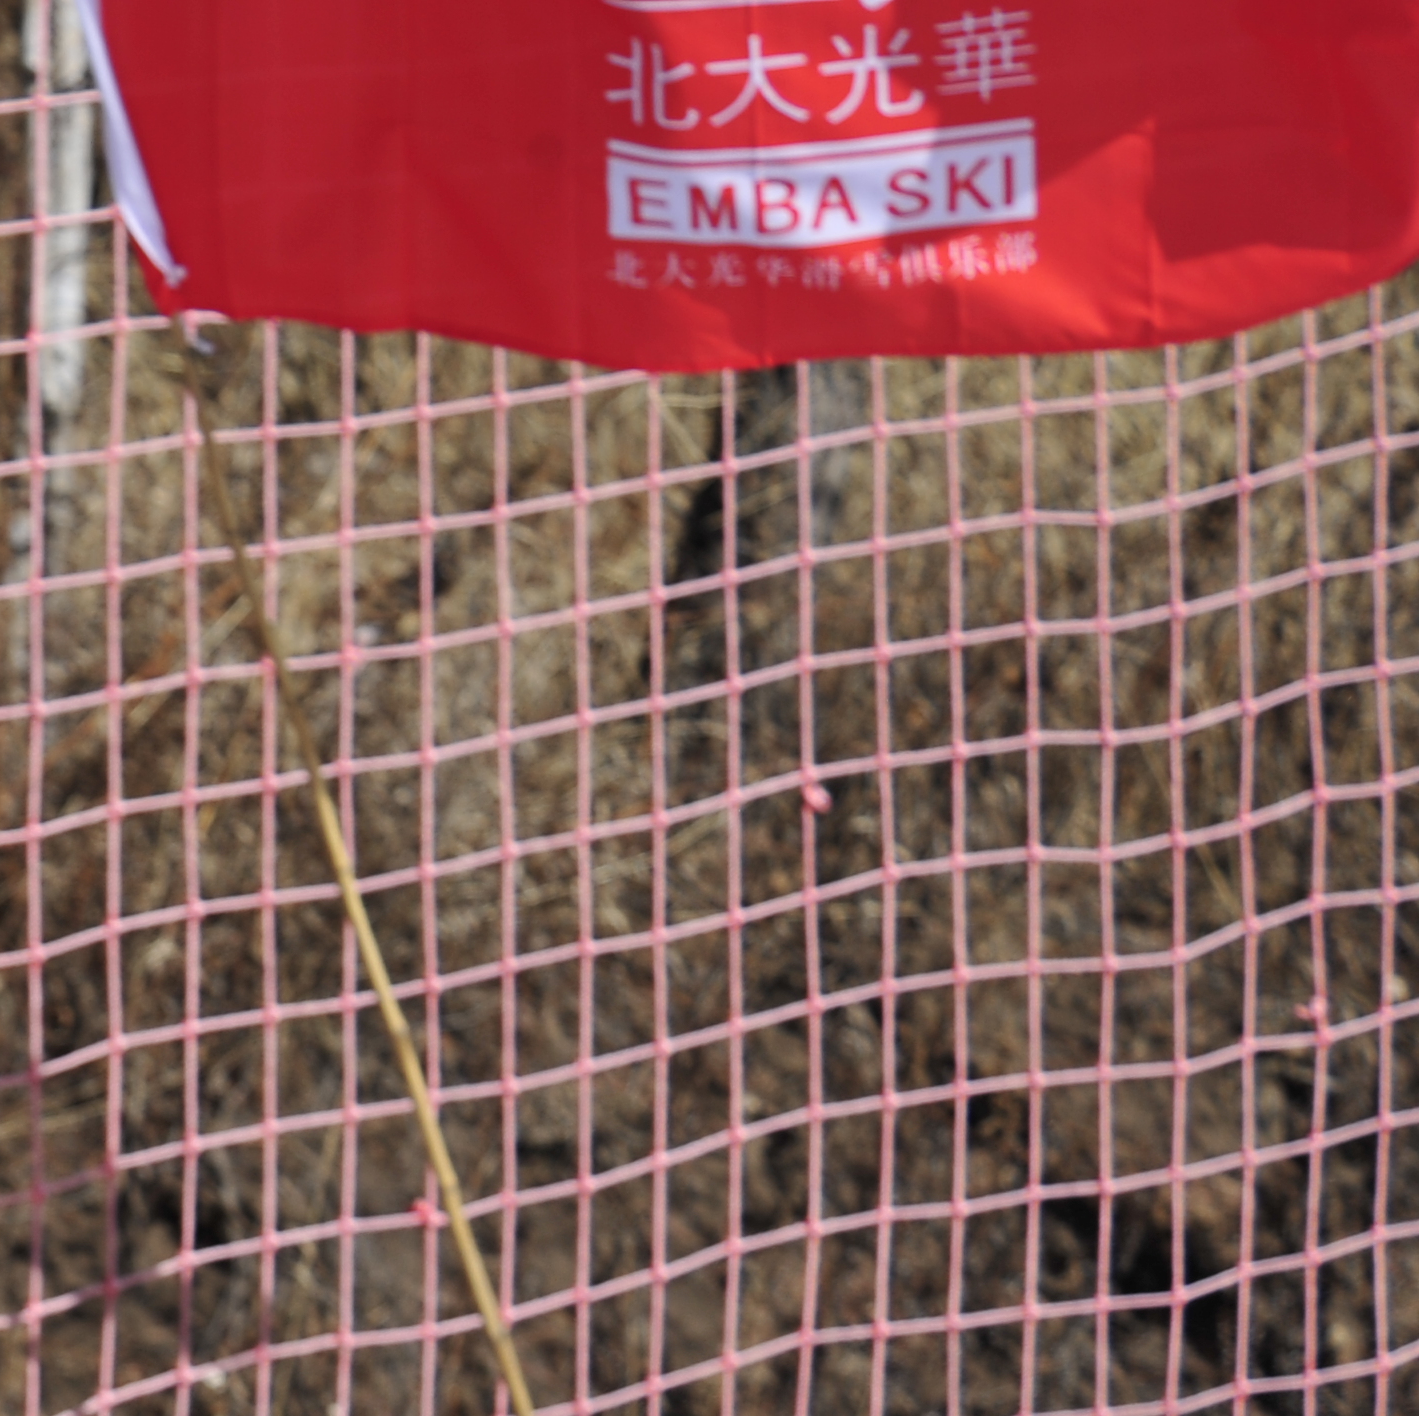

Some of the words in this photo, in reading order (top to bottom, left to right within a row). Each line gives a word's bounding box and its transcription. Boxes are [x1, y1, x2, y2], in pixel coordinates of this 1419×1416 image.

[605, 8, 1037, 131] 北大光華
[627, 174, 859, 236] EMBA
[885, 154, 1017, 220] SKI
